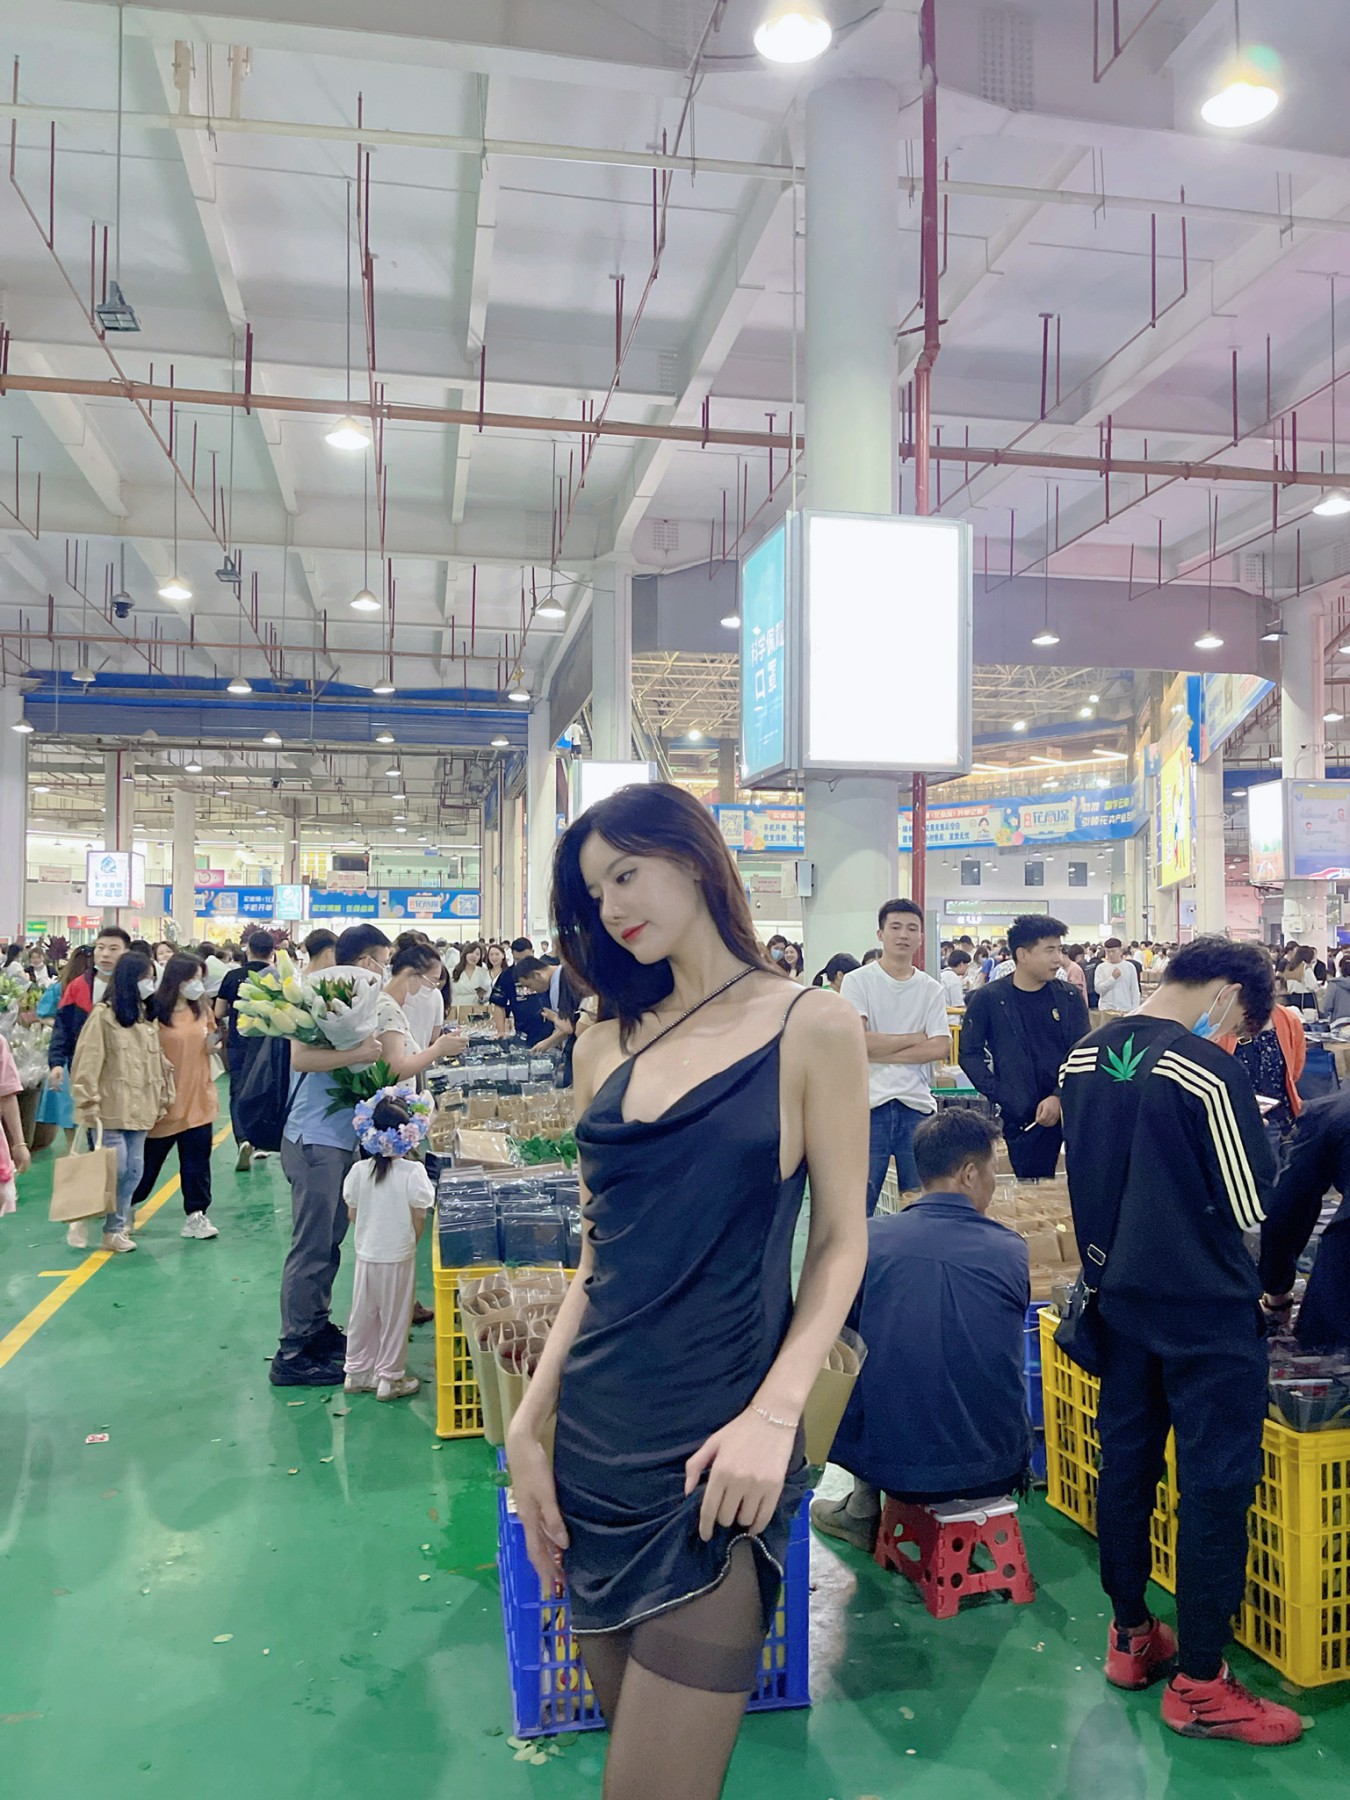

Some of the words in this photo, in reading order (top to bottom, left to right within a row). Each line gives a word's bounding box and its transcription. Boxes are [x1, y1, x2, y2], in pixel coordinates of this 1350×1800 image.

[755, 658, 777, 698] 口罩
[95, 889, 123, 898] 欢迎您
[243, 903, 273, 912] 手机开单
